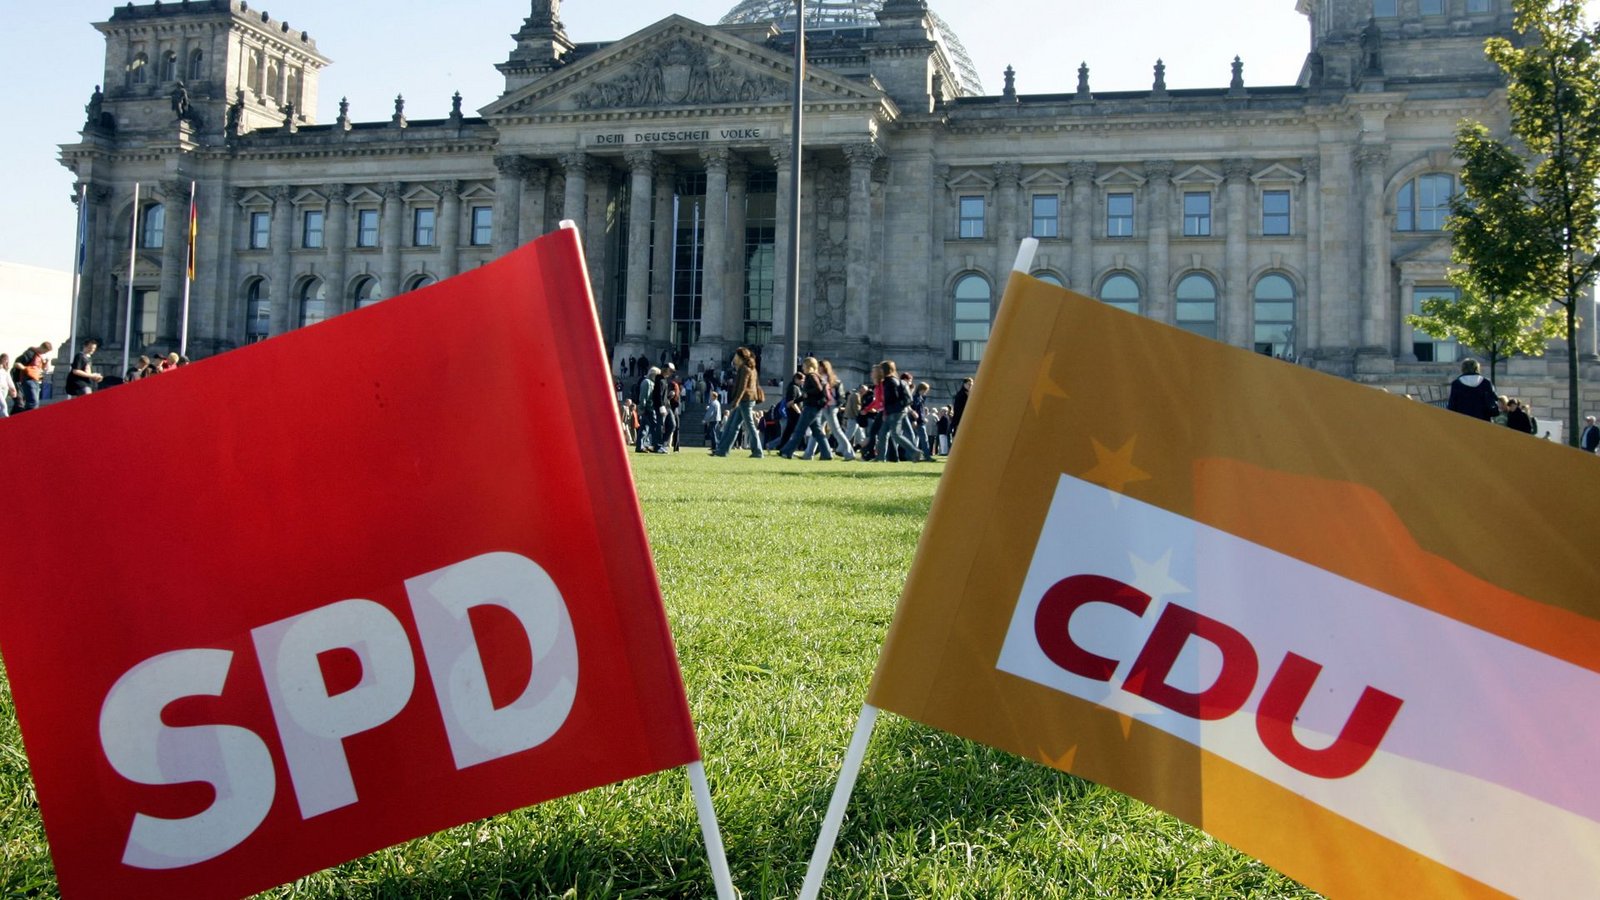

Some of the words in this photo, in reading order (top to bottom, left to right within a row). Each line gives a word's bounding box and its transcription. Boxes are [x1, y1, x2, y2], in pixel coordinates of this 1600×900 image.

[597, 133, 624, 144] DEM
[635, 130, 709, 142] DEUTSCHEN
[721, 128, 760, 139] VOLKE
[99, 551, 579, 870] SPD
[1034, 574, 1404, 779] CDU
